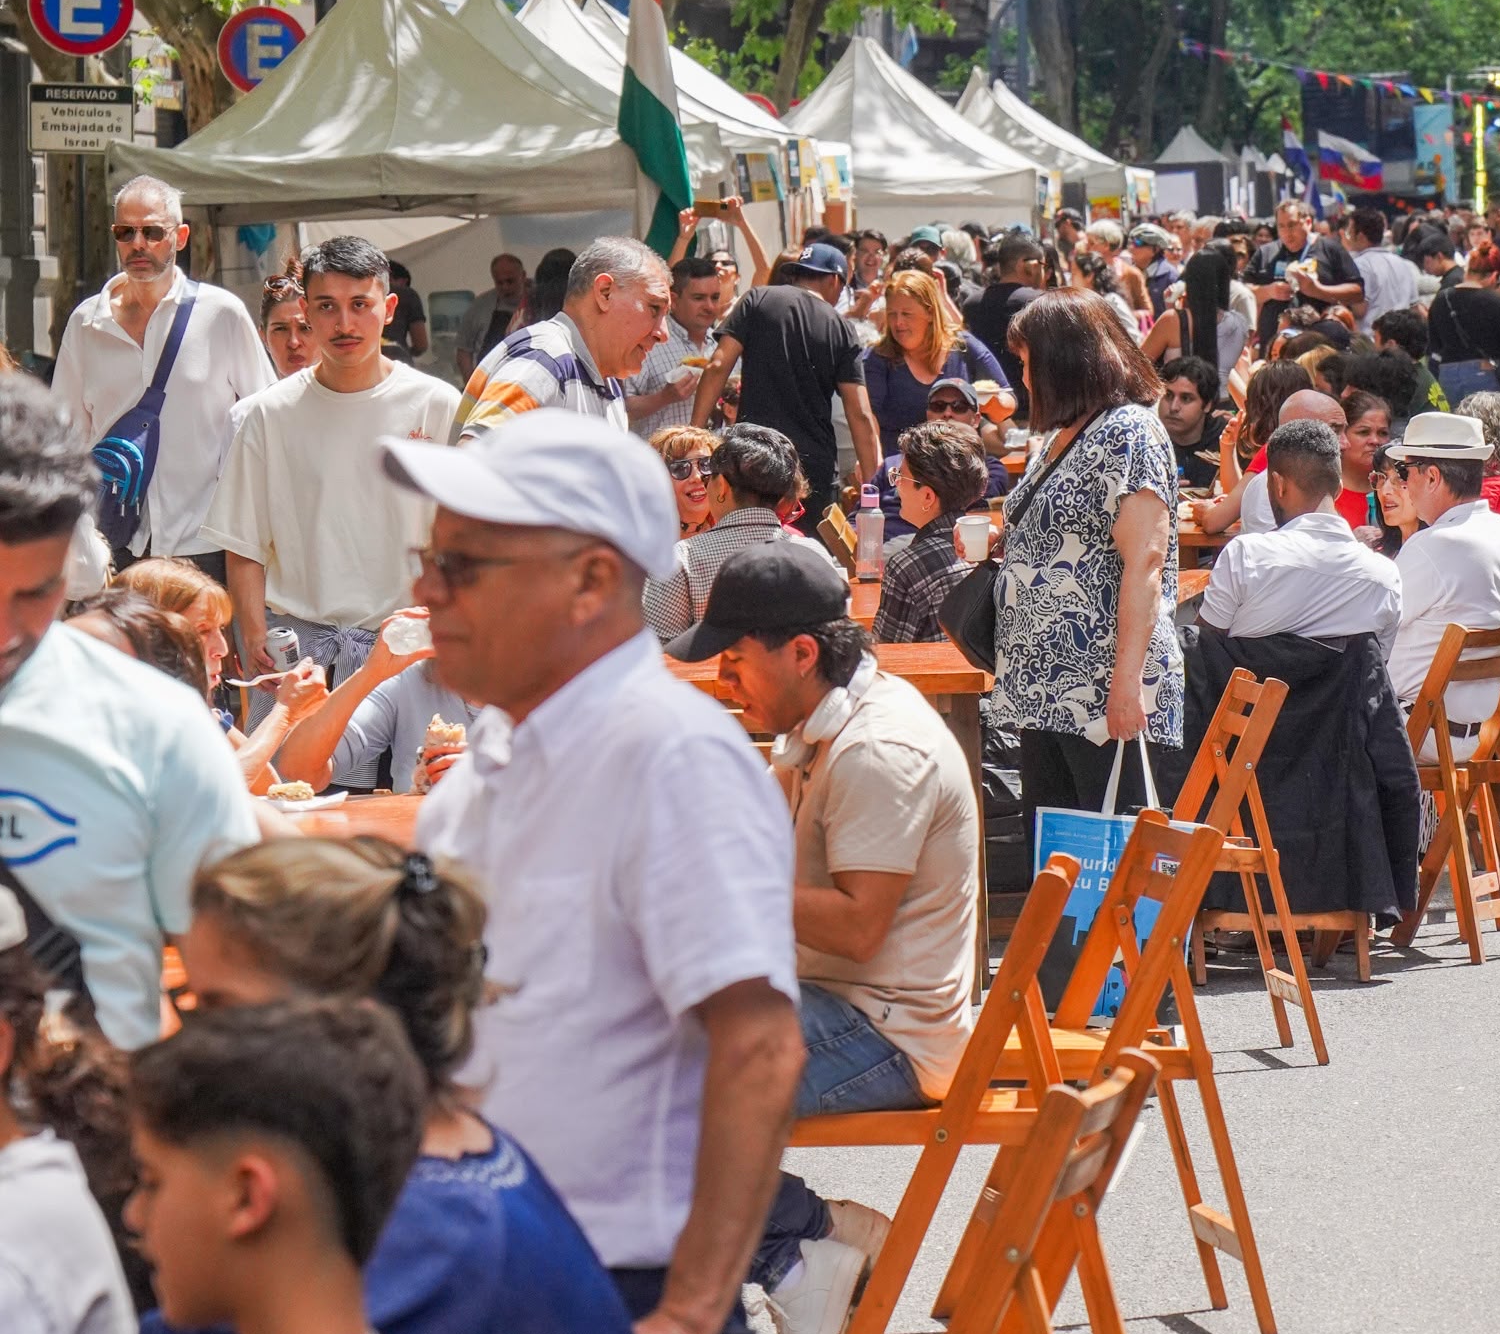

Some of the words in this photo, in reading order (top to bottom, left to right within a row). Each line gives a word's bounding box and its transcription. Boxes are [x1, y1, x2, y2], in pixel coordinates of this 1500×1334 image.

[247, 24, 282, 79] E
[45, 89, 117, 100] RESERVADO
[41, 122, 104, 133] Embajada
[106, 123, 122, 133] de
[64, 137, 99, 147] Israel
